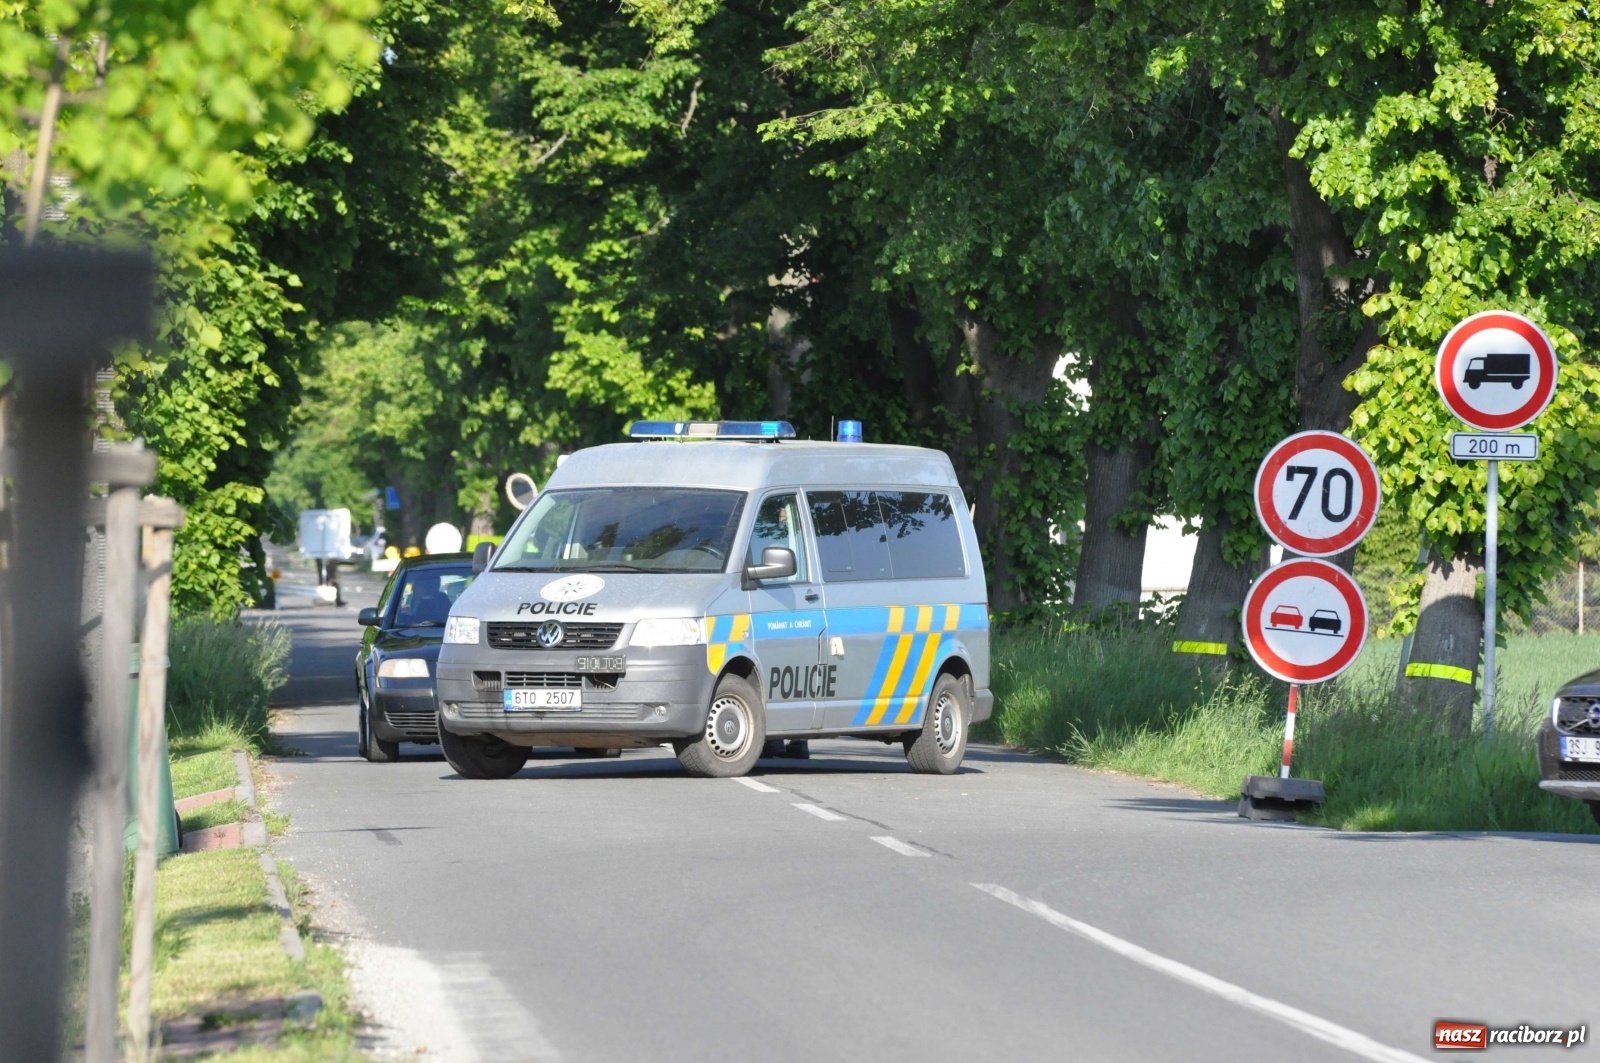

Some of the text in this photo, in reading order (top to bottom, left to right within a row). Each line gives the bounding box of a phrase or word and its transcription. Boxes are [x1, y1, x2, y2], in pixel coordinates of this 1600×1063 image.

[1469, 439, 1520, 454] 200 m
[1286, 465, 1354, 523] 70
[517, 601, 598, 616] POLICIE
[768, 665, 837, 699] POLICIE
[546, 692, 575, 704] 2507
[1569, 739, 1587, 755] 3SJ
